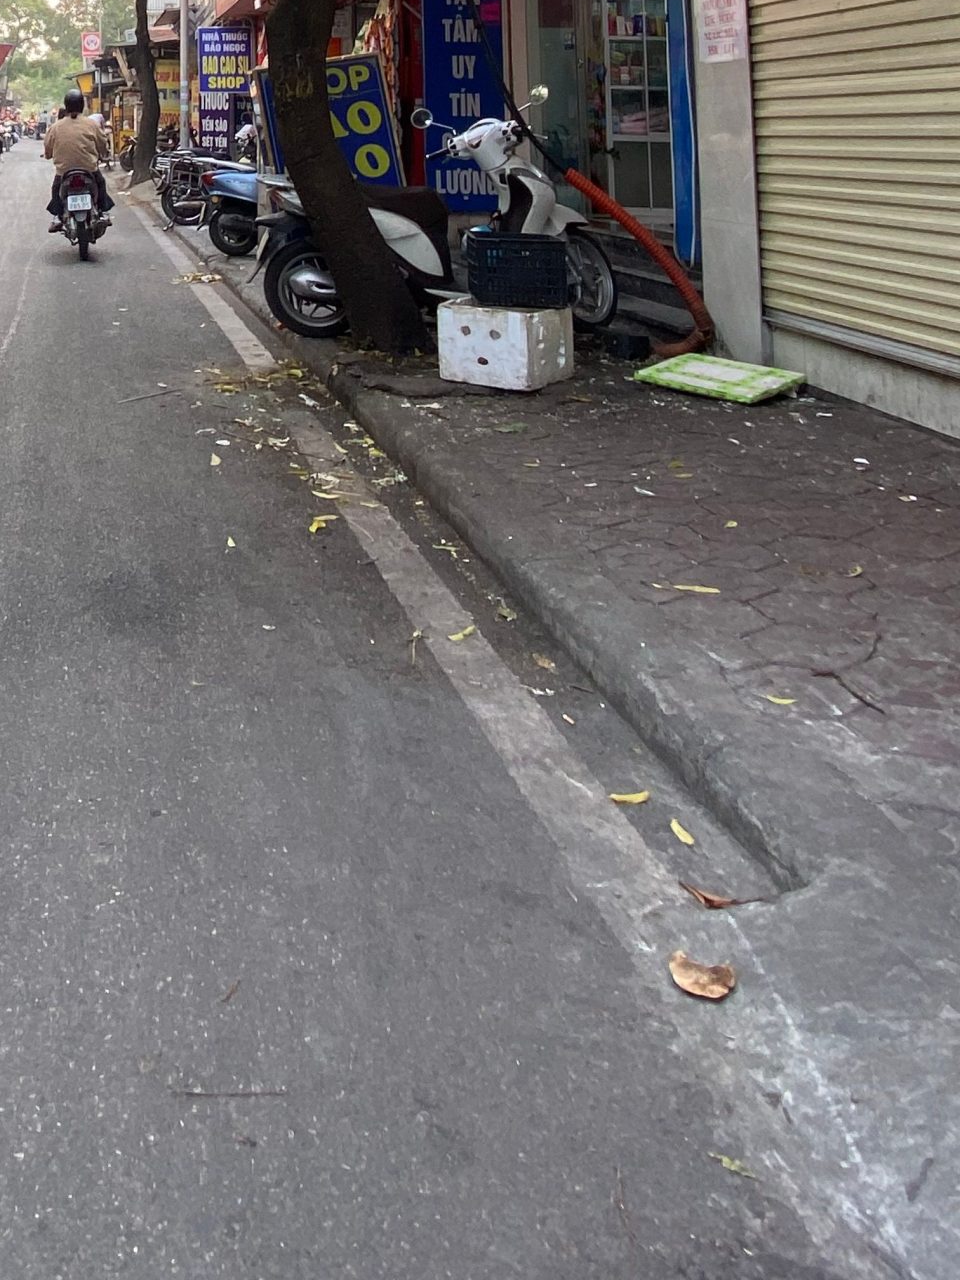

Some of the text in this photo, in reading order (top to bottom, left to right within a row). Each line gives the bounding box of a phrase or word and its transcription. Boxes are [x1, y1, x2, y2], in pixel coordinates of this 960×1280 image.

[442, 14, 480, 42] TÂM
[202, 55, 219, 74] BAO
[220, 55, 236, 74] CAO
[452, 55, 476, 80] UY
[208, 76, 245, 89] SHOP
[449, 88, 480, 117] TÍN
